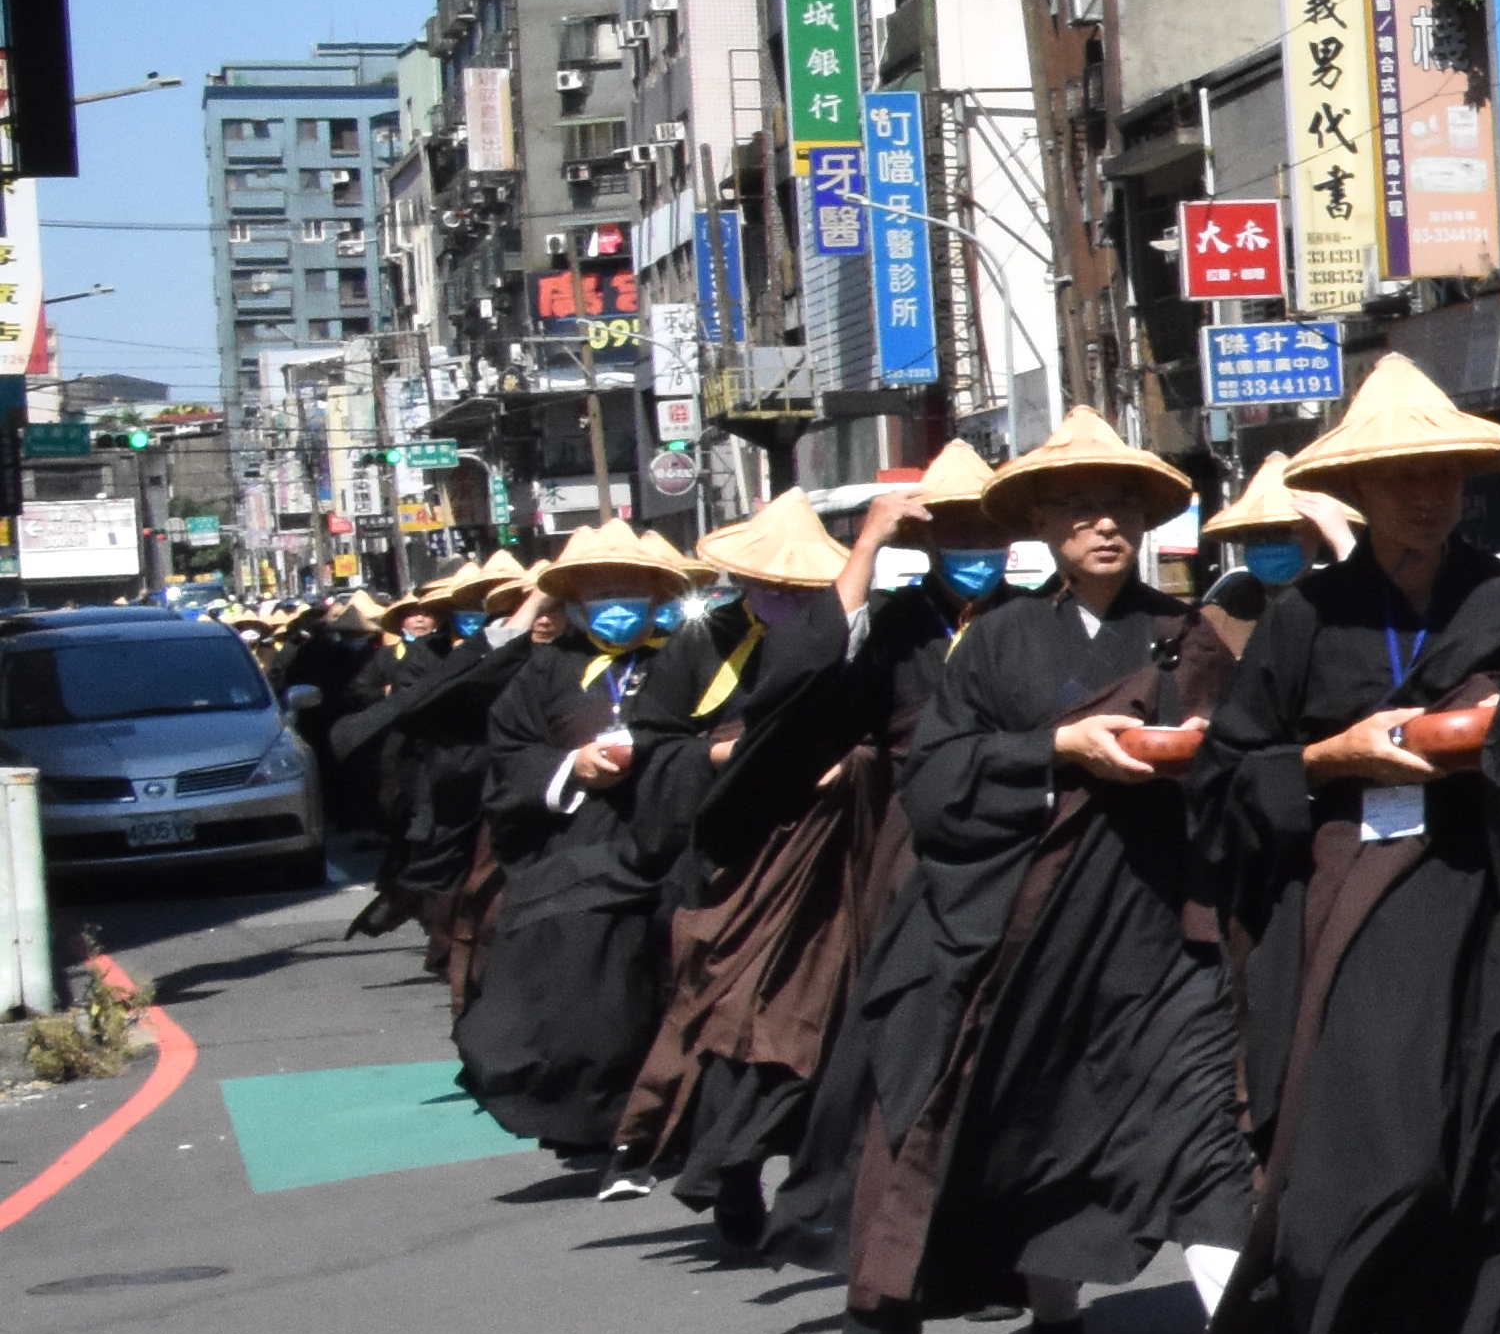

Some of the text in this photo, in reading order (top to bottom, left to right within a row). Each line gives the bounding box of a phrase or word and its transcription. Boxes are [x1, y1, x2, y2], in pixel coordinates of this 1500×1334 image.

[816, 152, 861, 248] 牙醫
[870, 108, 918, 328] 叮噹牙醫診所
[1242, 376, 1333, 397] 3344191
